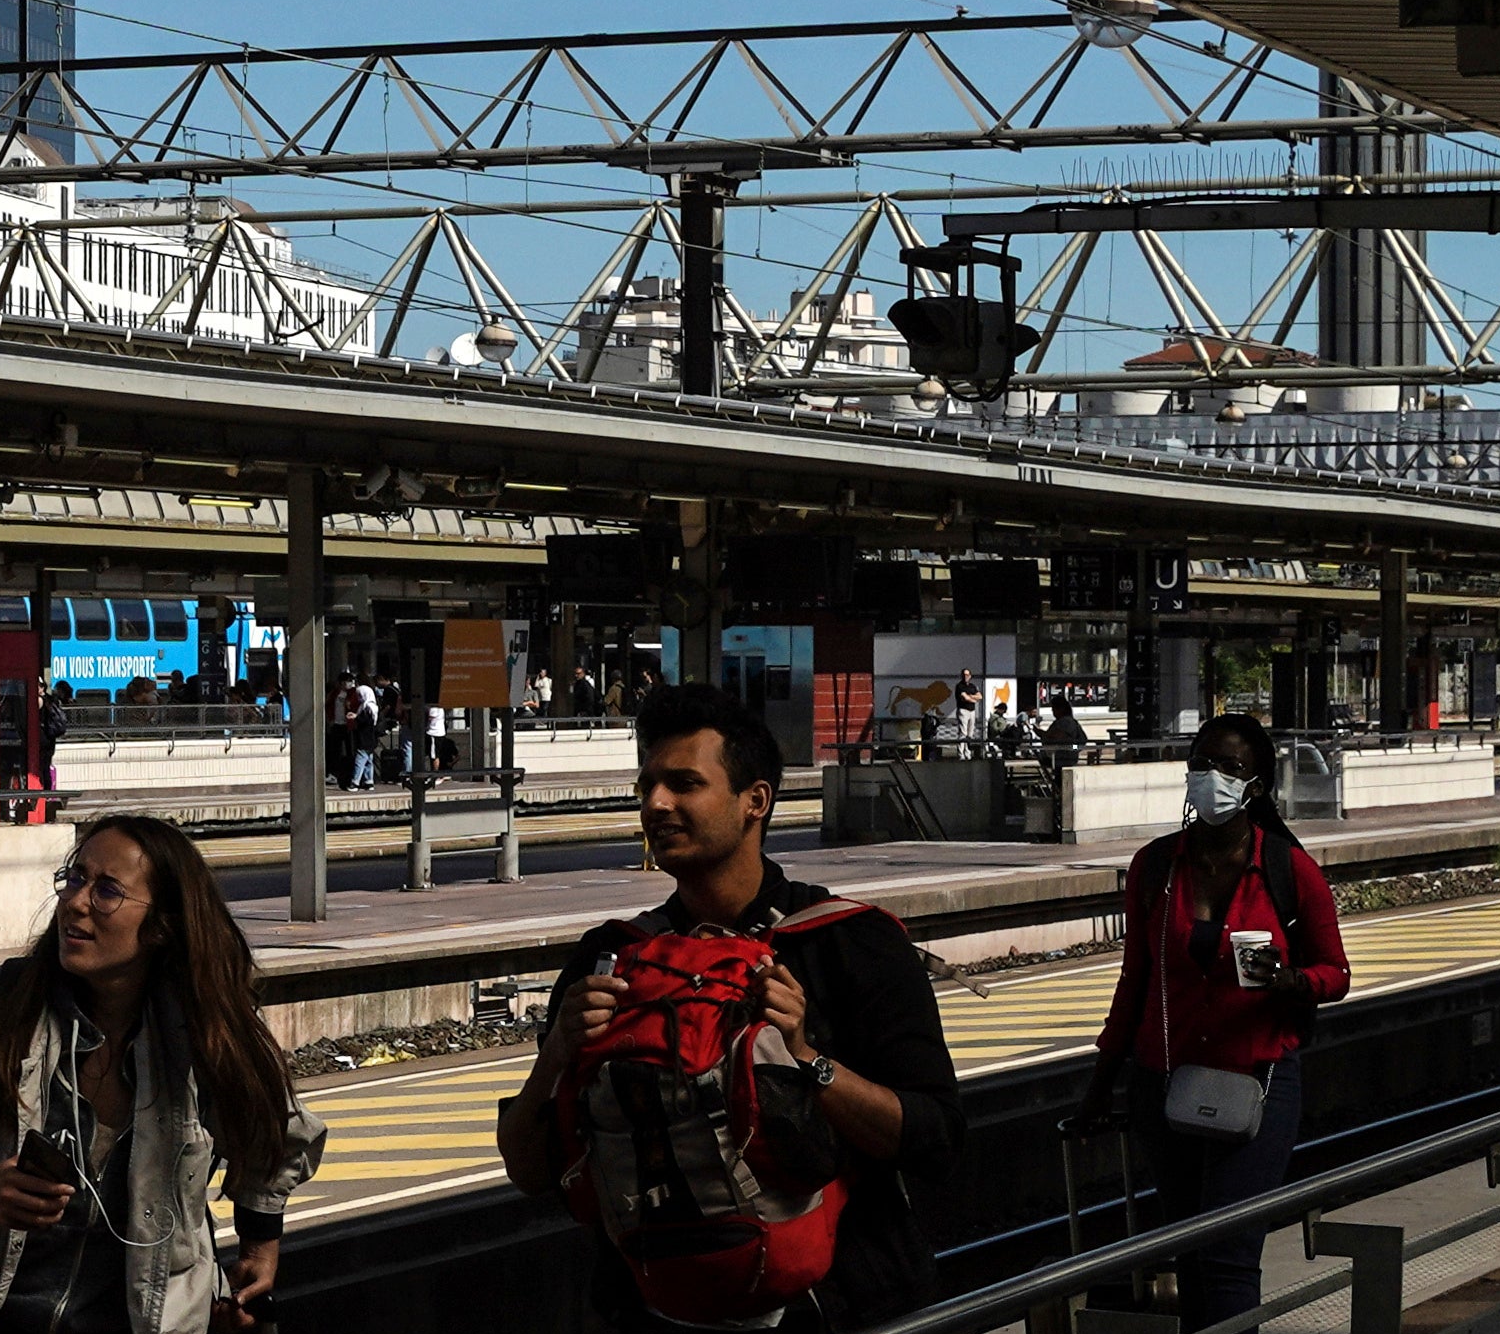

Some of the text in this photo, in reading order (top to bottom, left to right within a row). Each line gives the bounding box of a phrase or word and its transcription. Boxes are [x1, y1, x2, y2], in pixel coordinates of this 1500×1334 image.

[1155, 558, 1178, 589] U
[69, 655, 95, 678] VOUS
[96, 655, 156, 678] TRANSPORTE
